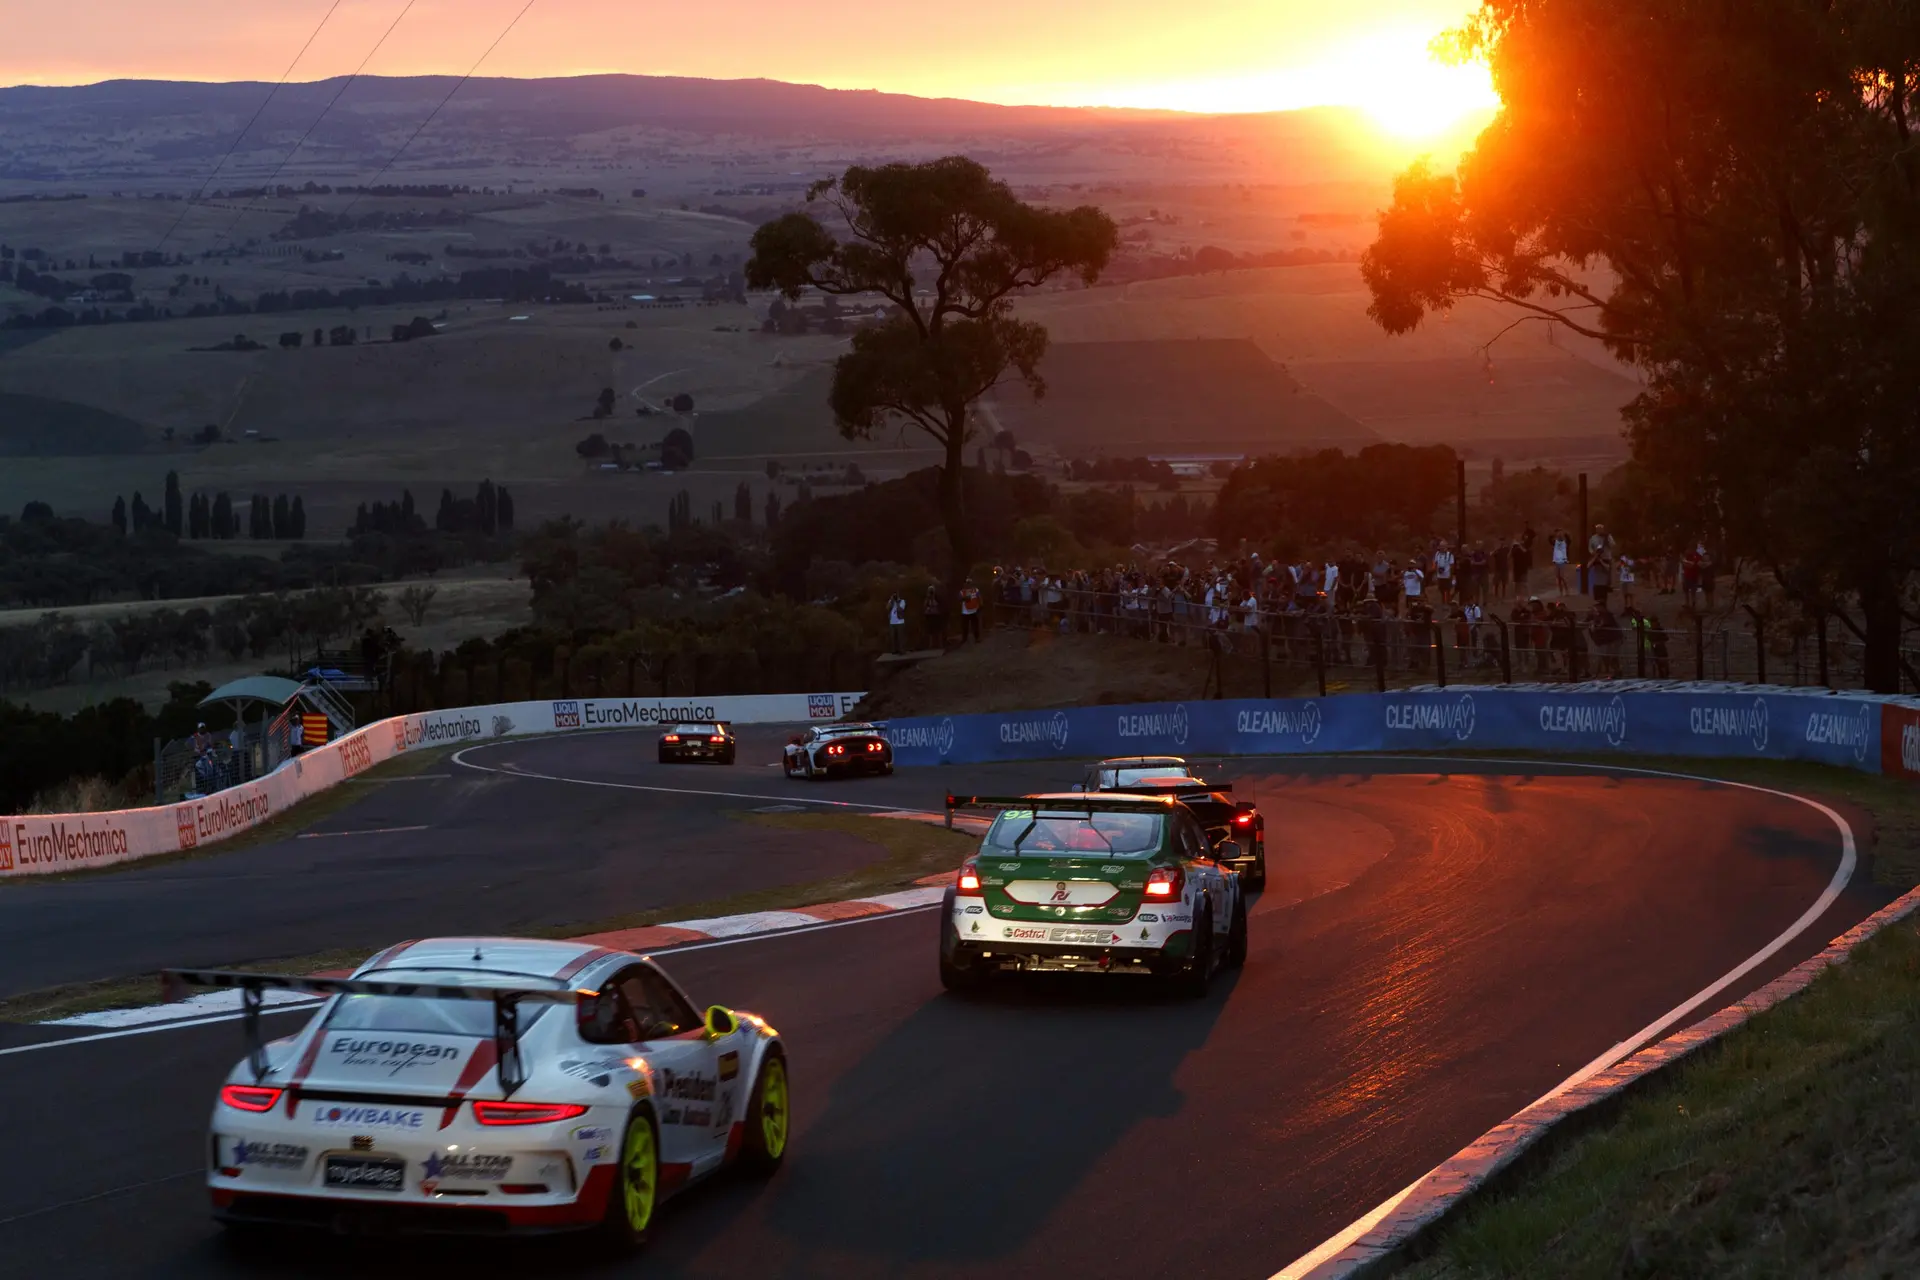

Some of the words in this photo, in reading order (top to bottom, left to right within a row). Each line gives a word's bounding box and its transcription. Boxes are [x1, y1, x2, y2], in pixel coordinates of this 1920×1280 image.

[554, 703, 577, 714] LIQUI
[585, 701, 715, 723] EuroMechanica
[809, 696, 833, 706] LIQUI
[810, 706, 834, 717] MOLY
[556, 714, 579, 726] MOLY
[1118, 714, 1184, 737] CLEANAWAY
[1237, 710, 1316, 733] CLEANAWAY
[1386, 704, 1471, 730] CLEANAWAY
[1540, 706, 1621, 733] CLEANAWAY
[1690, 708, 1764, 737] CLEANAWAY
[404, 715, 480, 744] EuroMechanica
[891, 726, 950, 748] CLEANAWAY
[1001, 720, 1064, 743] CLEANAWAY
[1806, 712, 1867, 746] CLEANAWAY
[197, 788, 268, 837] EuroMechanica
[16, 820, 128, 864] EuroMechanica
[1014, 928, 1046, 939] Castrol
[1049, 928, 1114, 943] EDGE
[331, 1037, 459, 1060] European
[314, 1106, 424, 1128] LOWBAKE
